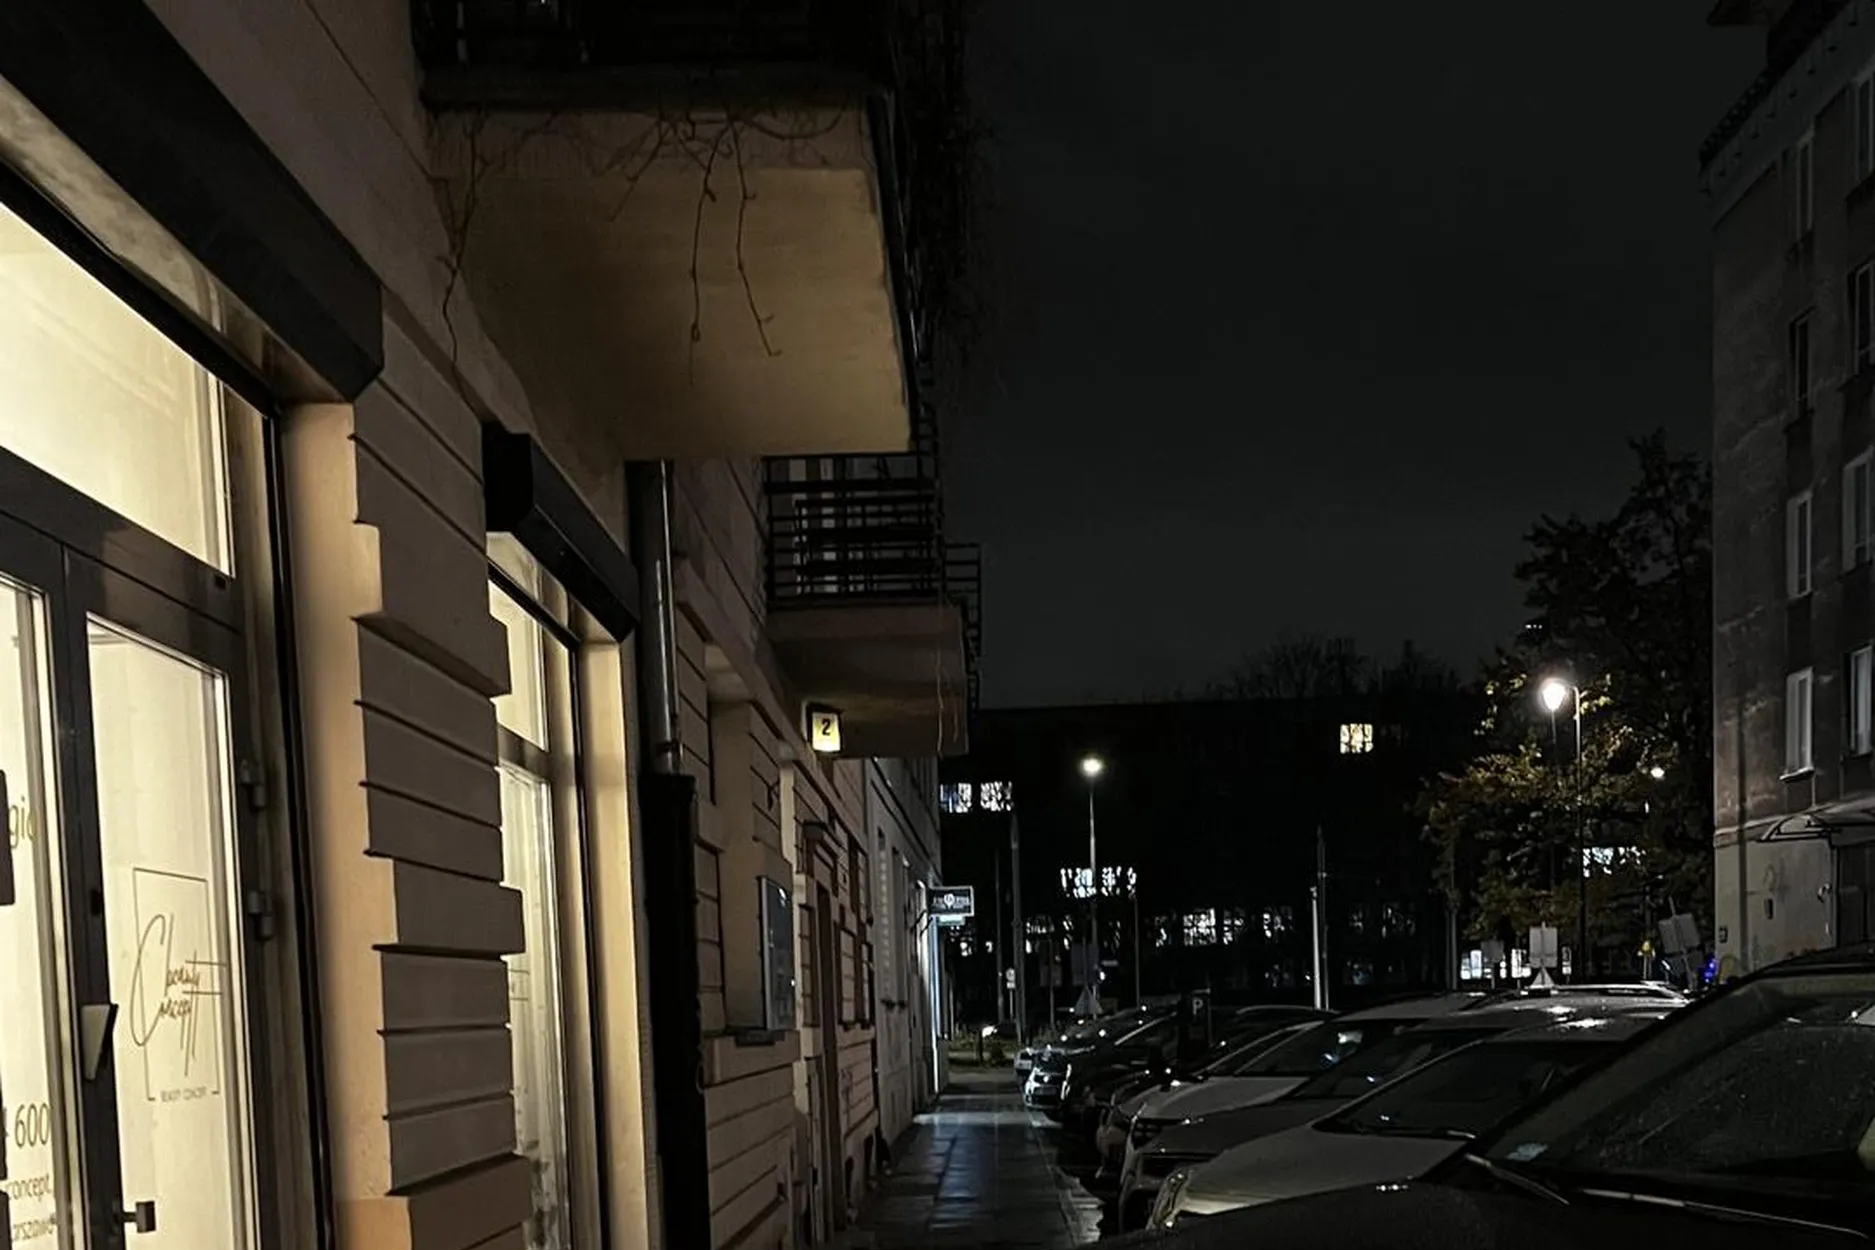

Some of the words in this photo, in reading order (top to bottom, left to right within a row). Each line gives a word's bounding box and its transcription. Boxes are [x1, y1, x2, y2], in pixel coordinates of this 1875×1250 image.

[822, 718, 831, 735] 2
[1193, 998, 1204, 1015] P
[14, 1102, 51, 1150] 600
